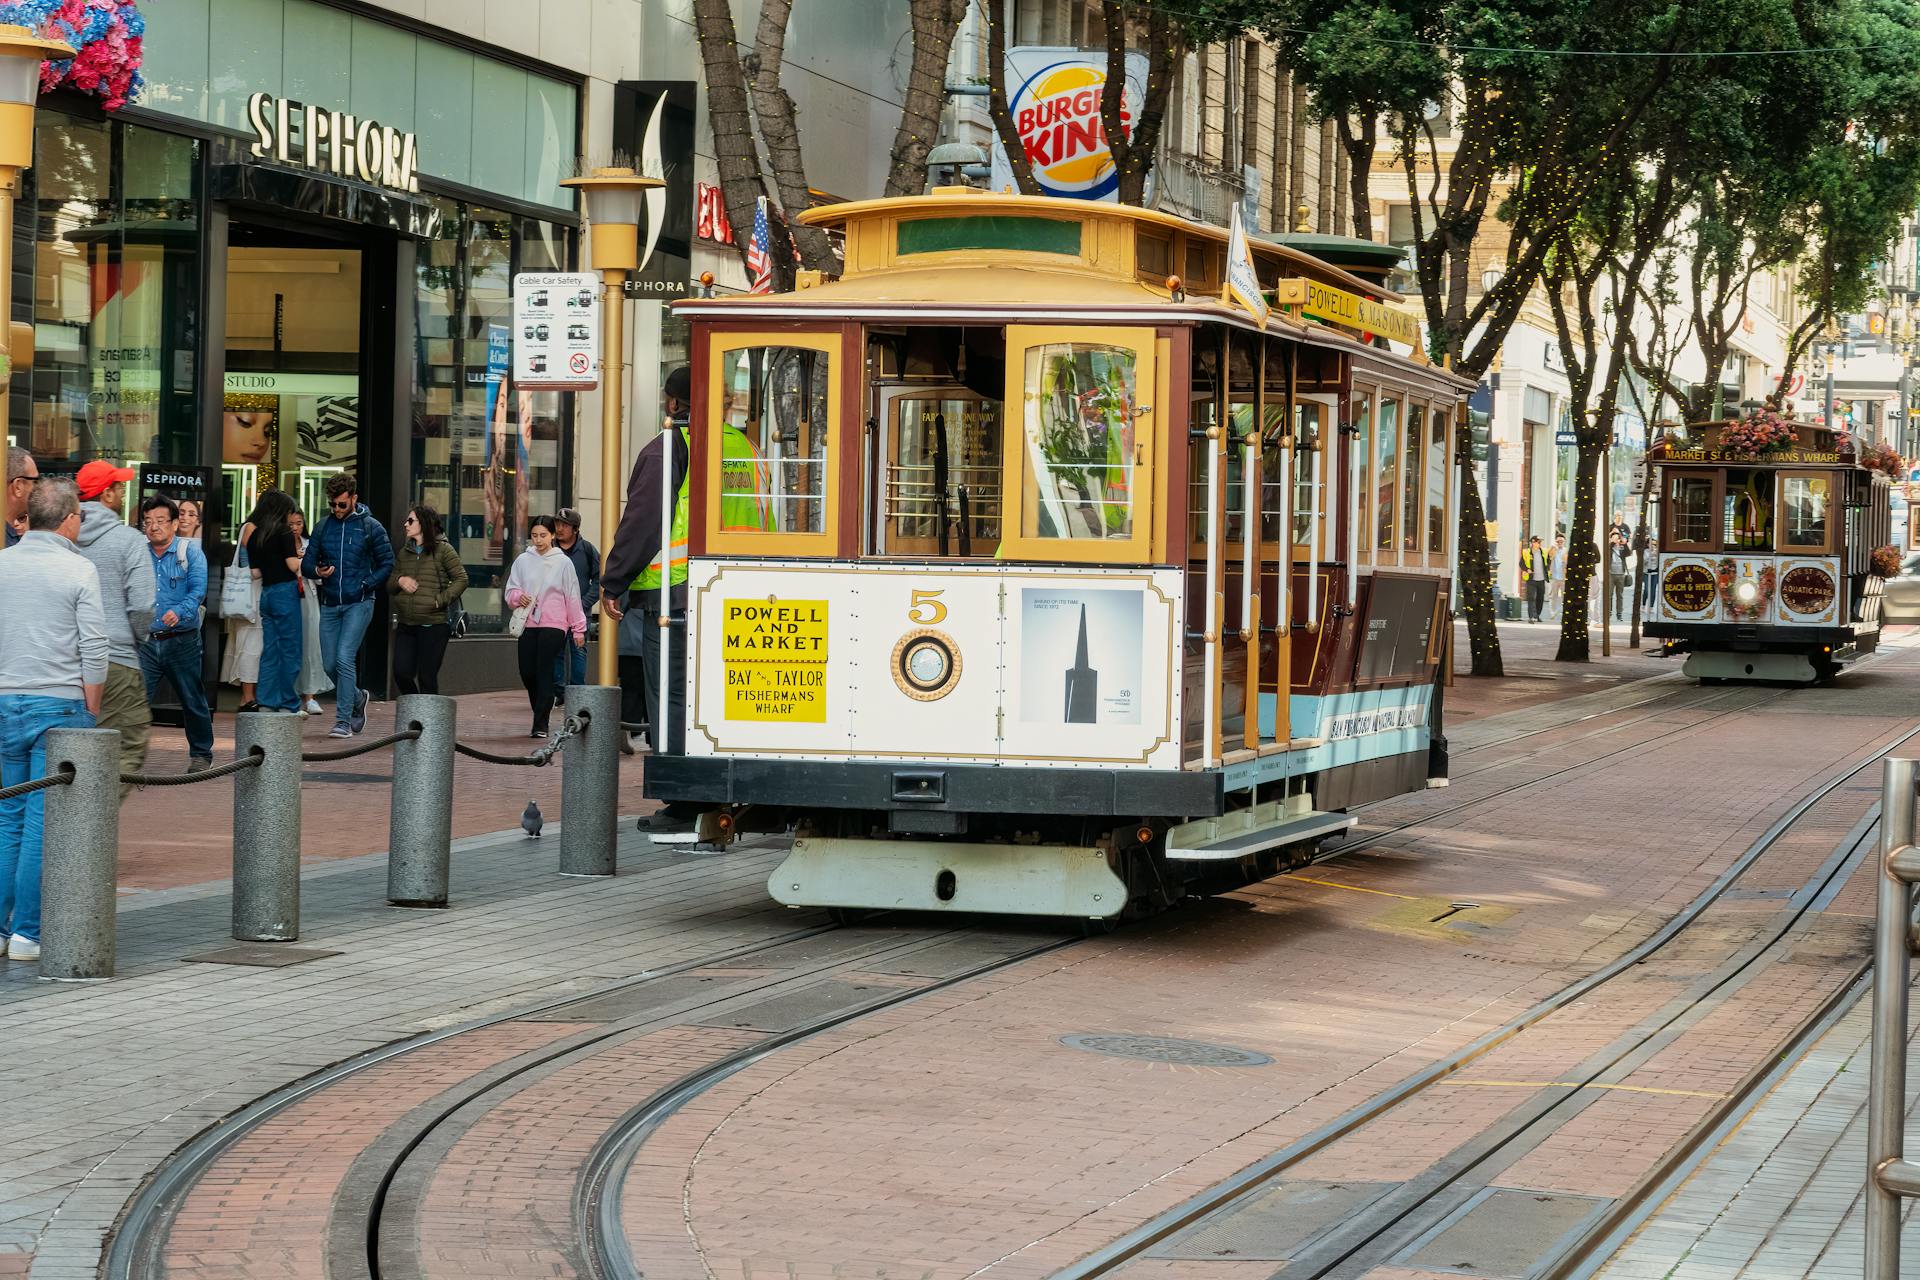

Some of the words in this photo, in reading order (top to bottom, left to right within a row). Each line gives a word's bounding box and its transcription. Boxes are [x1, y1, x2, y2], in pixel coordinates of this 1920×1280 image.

[247, 92, 420, 193] SEPHORA
[519, 277, 540, 285] Cable
[542, 277, 556, 285] Car
[557, 277, 582, 287] Safety
[624, 280, 685, 292] EPHORA
[1308, 286, 1352, 319] POWELL
[1357, 301, 1365, 323] &
[1369, 304, 1400, 334] MASON
[227, 375, 276, 388] STUDIO
[1665, 450, 1706, 461] MARKET
[1803, 452, 1841, 463] WHARF
[146, 473, 202, 486] SEPHORA
[1743, 562, 1754, 577] 1
[1665, 583, 1686, 591] BEACH
[1695, 583, 1714, 591] HYDE
[1782, 585, 1813, 595] AQUATIC
[1813, 587, 1832, 596] PARK
[909, 589, 948, 625] 5
[730, 607, 823, 622] POWELL
[753, 623, 798, 633] AND
[727, 635, 823, 650] MARKET
[728, 670, 752, 685] BAY
[756, 671, 771, 686] AND
[774, 670, 823, 686] TAYLOR
[737, 690, 815, 702] FISHERMANS
[755, 703, 796, 714] WHARF
